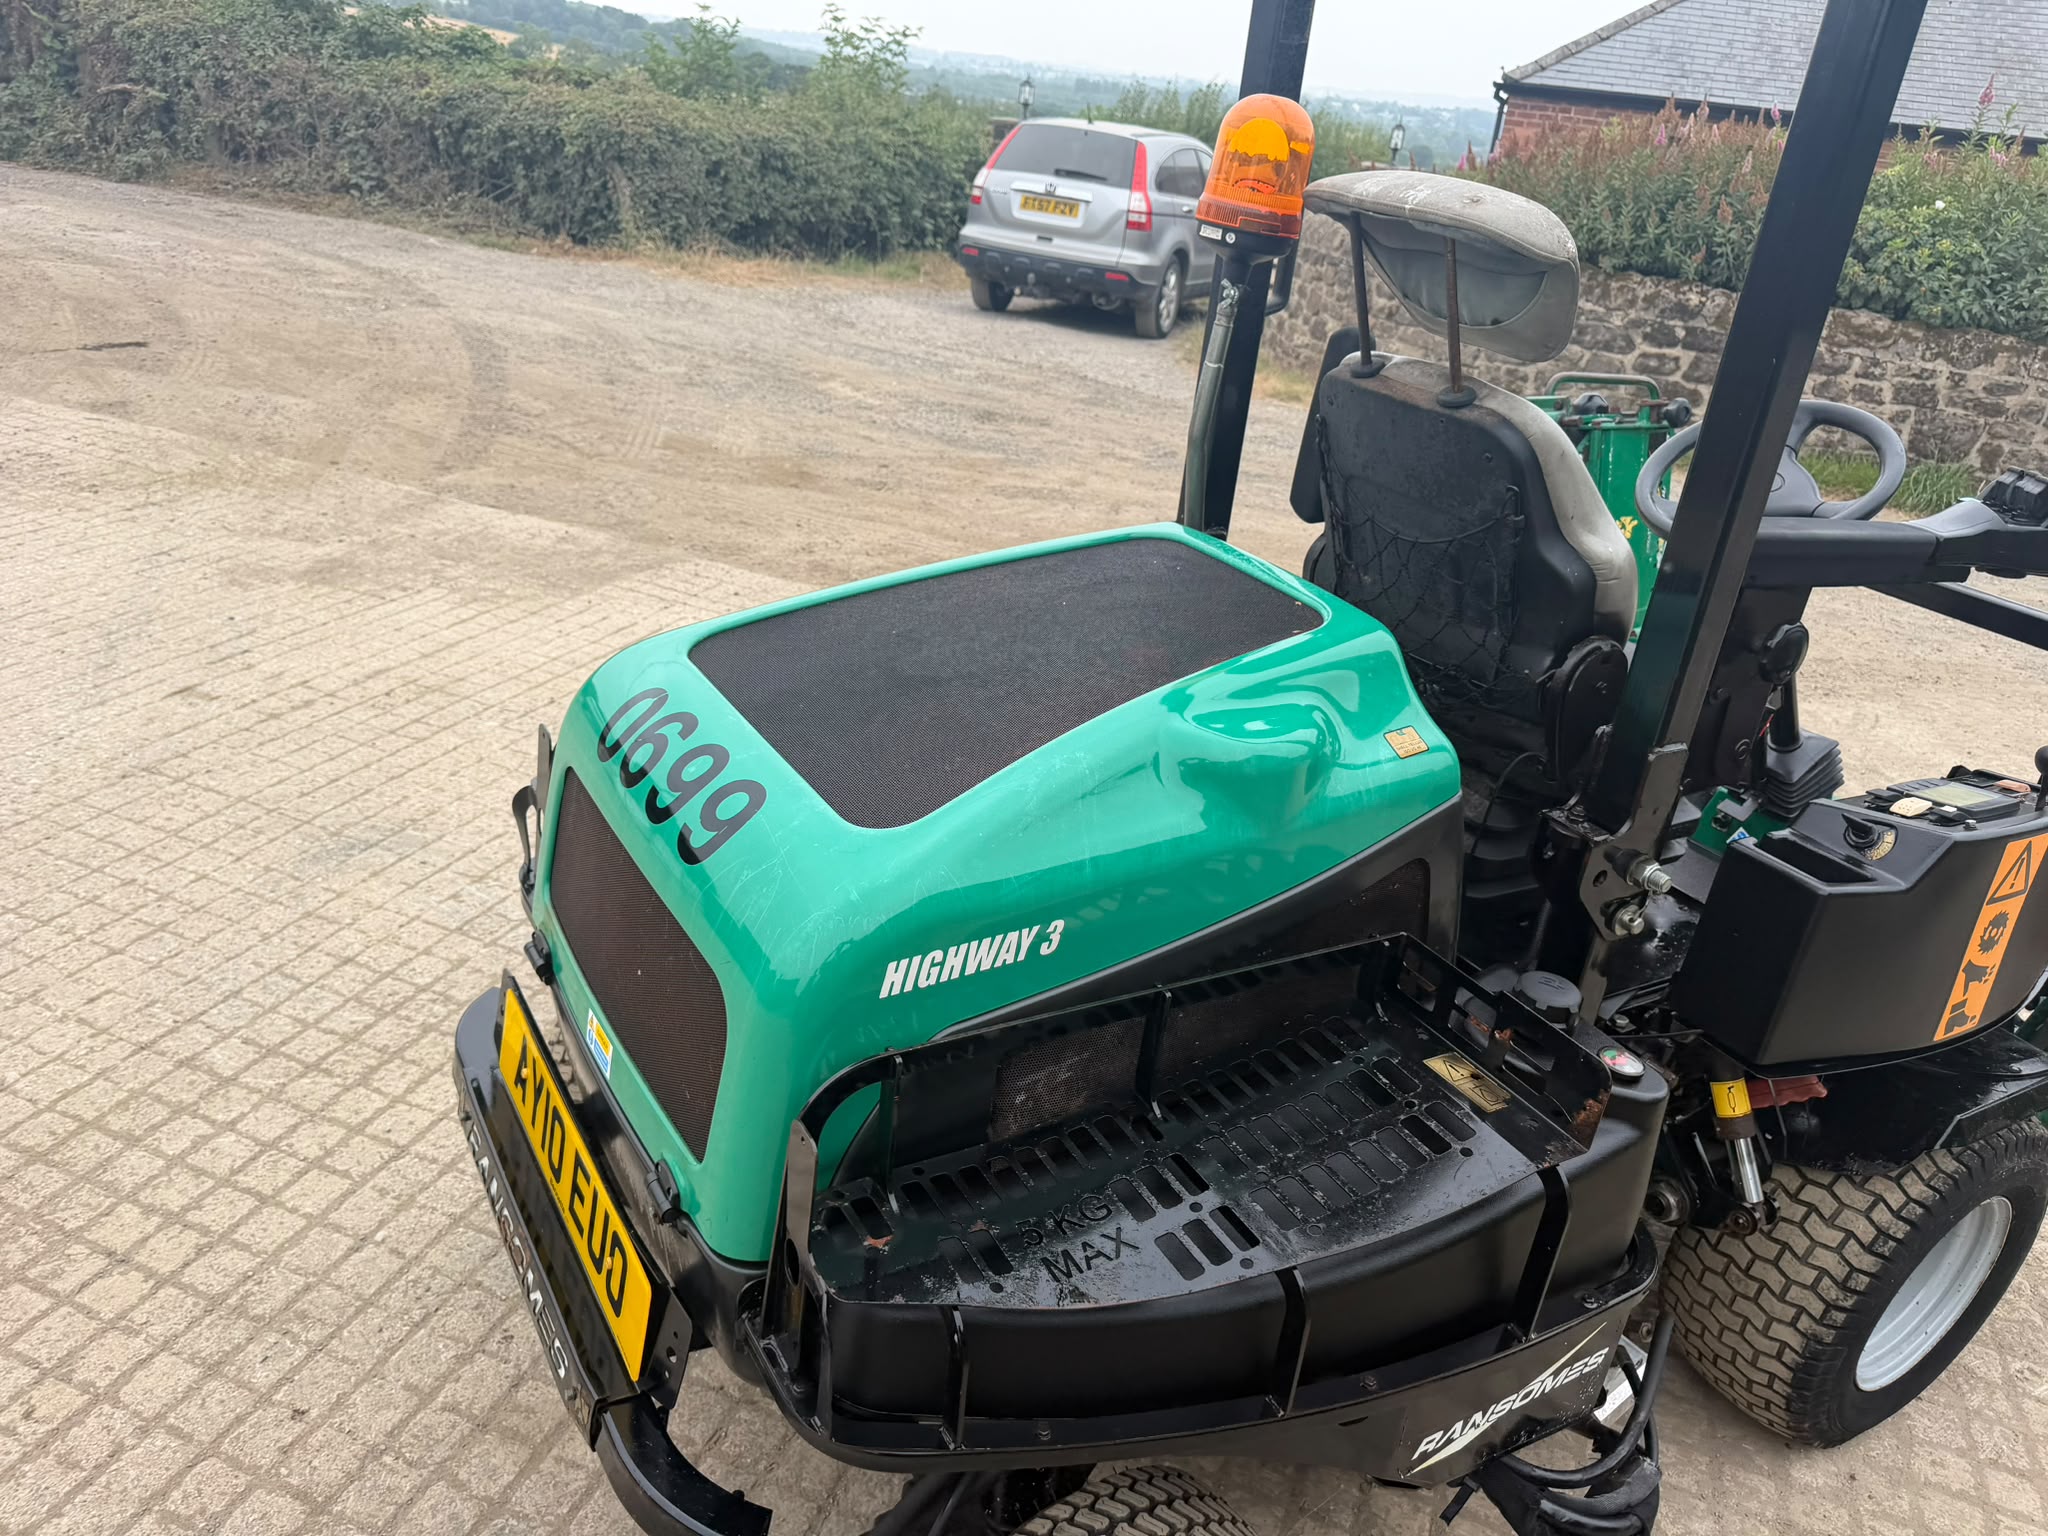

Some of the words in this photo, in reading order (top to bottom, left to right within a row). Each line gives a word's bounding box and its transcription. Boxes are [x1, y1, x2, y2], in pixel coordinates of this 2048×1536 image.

[597, 687, 767, 865] 0699
[879, 924, 1041, 999] HIGHWAY
[1039, 919, 1065, 956] 3
[513, 1034, 567, 1184] AY10
[568, 1148, 628, 1319] EUO
[1049, 1194, 1113, 1236] KG
[469, 1123, 569, 1380] RANSOMES
[1040, 1226, 1140, 1283] MAX
[1411, 1346, 1610, 1461] RANSOMES
